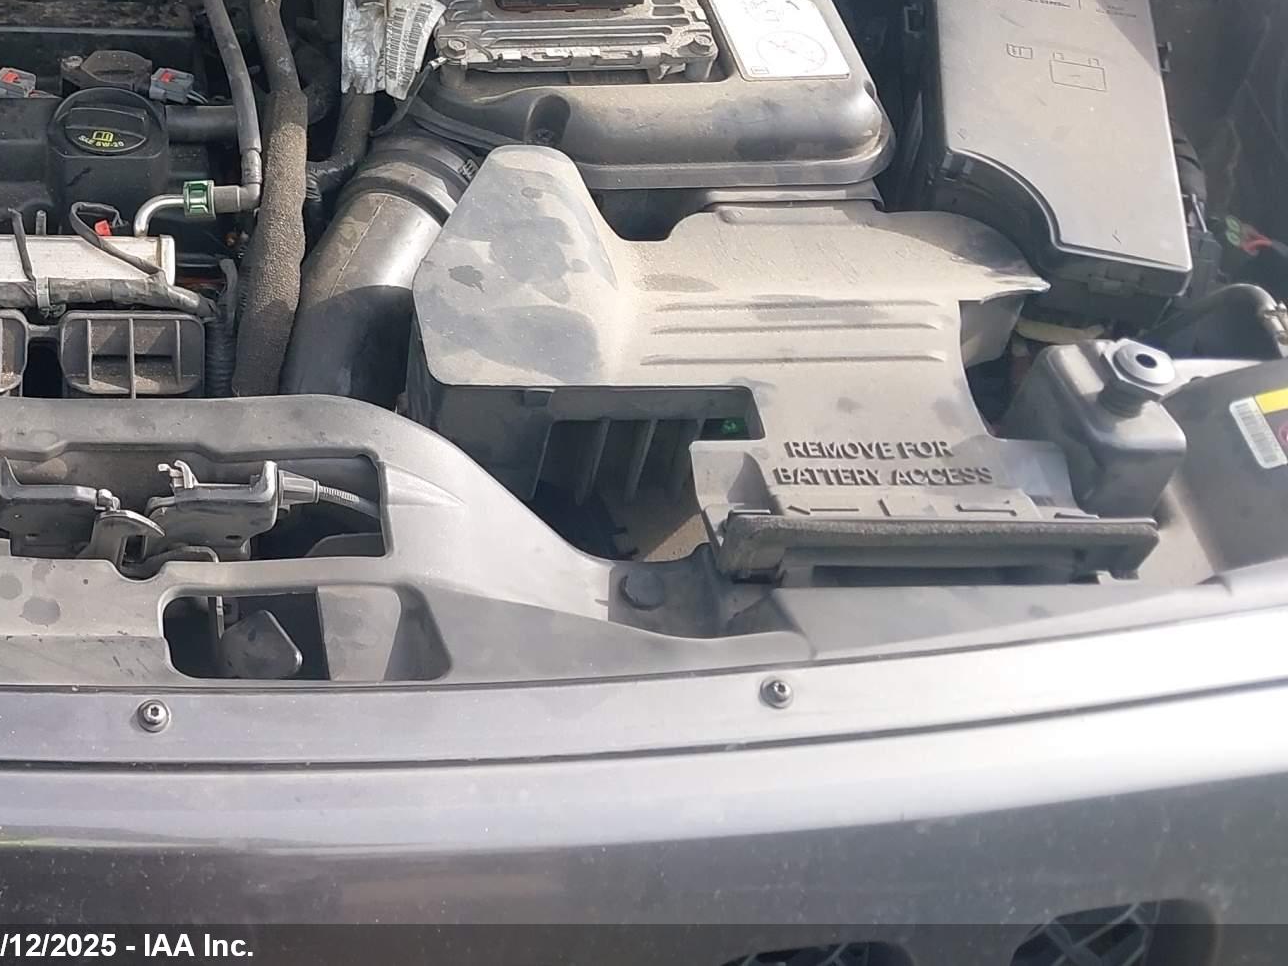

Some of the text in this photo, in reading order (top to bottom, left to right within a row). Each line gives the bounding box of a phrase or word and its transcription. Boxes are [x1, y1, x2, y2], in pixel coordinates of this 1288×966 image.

[784, 440, 954, 460] REMOVE FOR
[772, 466, 993, 485] BATTERY ACCESS
